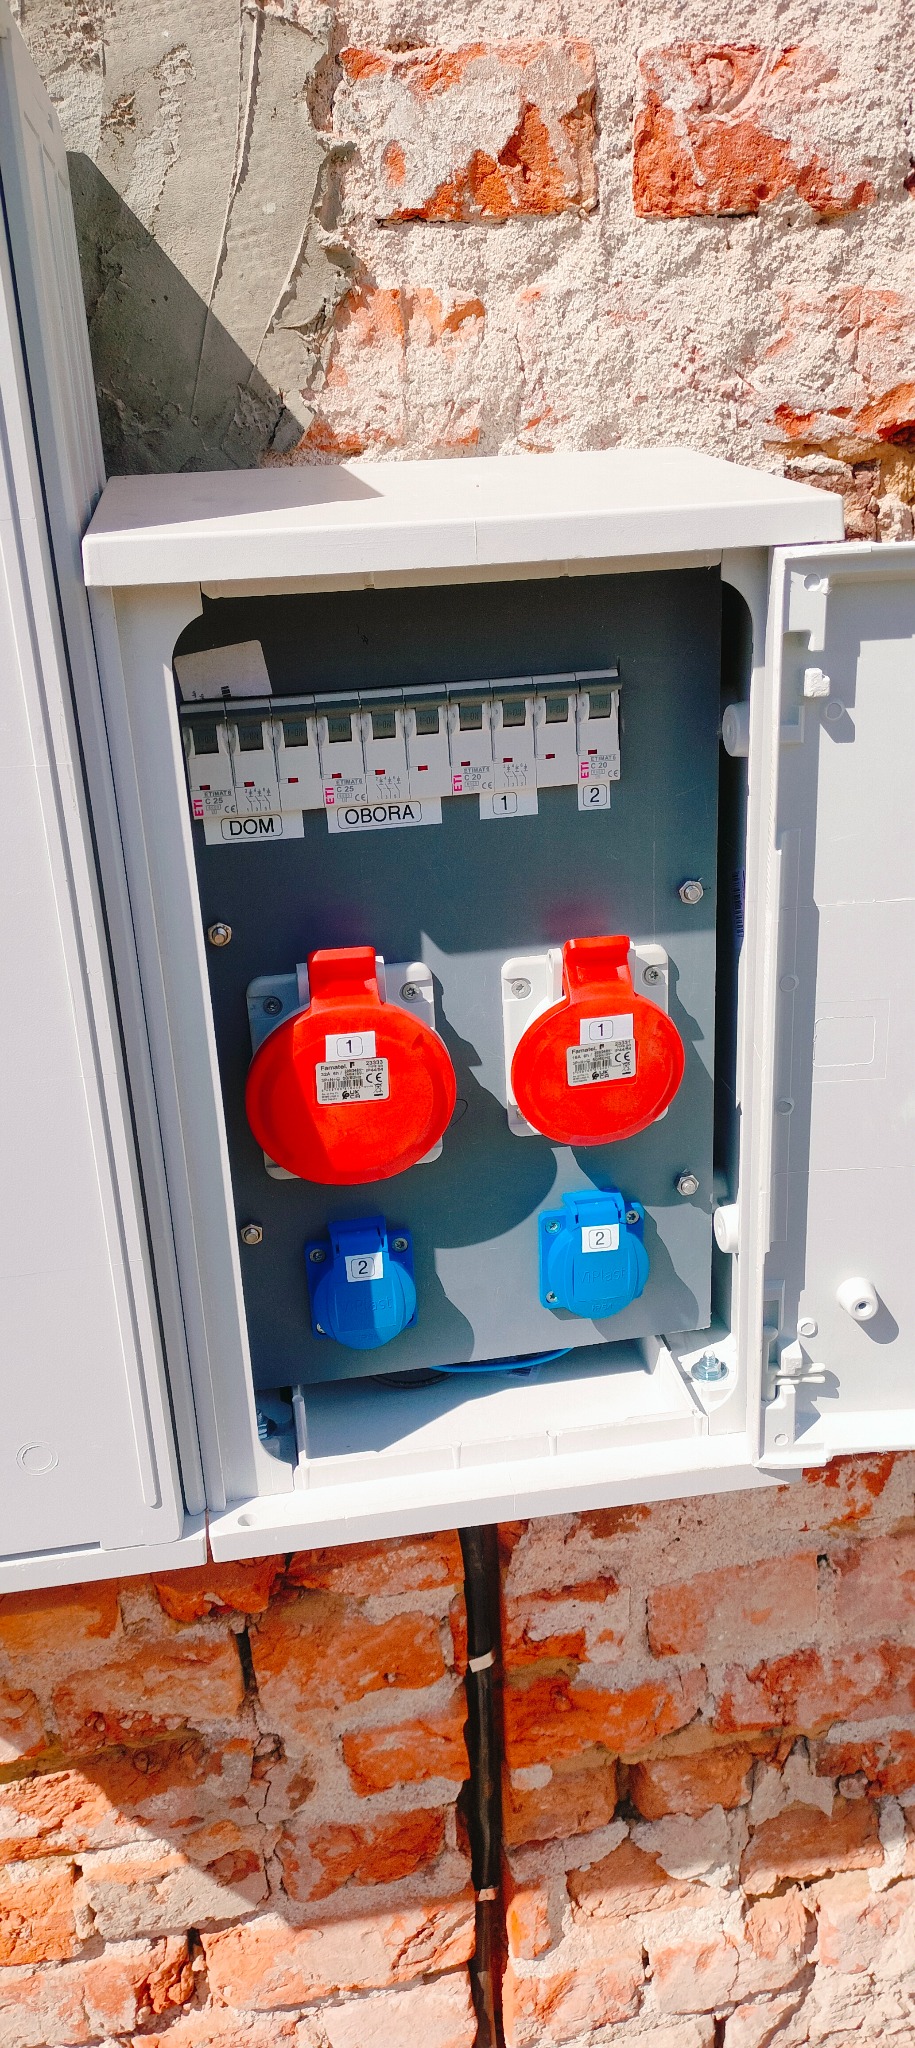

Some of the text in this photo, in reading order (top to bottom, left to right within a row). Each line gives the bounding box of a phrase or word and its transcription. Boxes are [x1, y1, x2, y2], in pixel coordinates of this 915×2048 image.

[580, 762, 589, 779] ETI
[453, 775, 463, 791] ETI
[325, 787, 335, 804] ETI
[590, 788, 600, 802] 2
[193, 799, 204, 816] ETI
[501, 795, 507, 811] 1
[345, 805, 415, 824] OBORA
[230, 817, 274, 835] DOM
[598, 1023, 603, 1036] 1
[346, 1040, 352, 1053] 1
[615, 1052, 631, 1062] CE
[366, 1073, 382, 1083] CE
[595, 1231, 605, 1245] 2
[358, 1260, 368, 1274] 2
